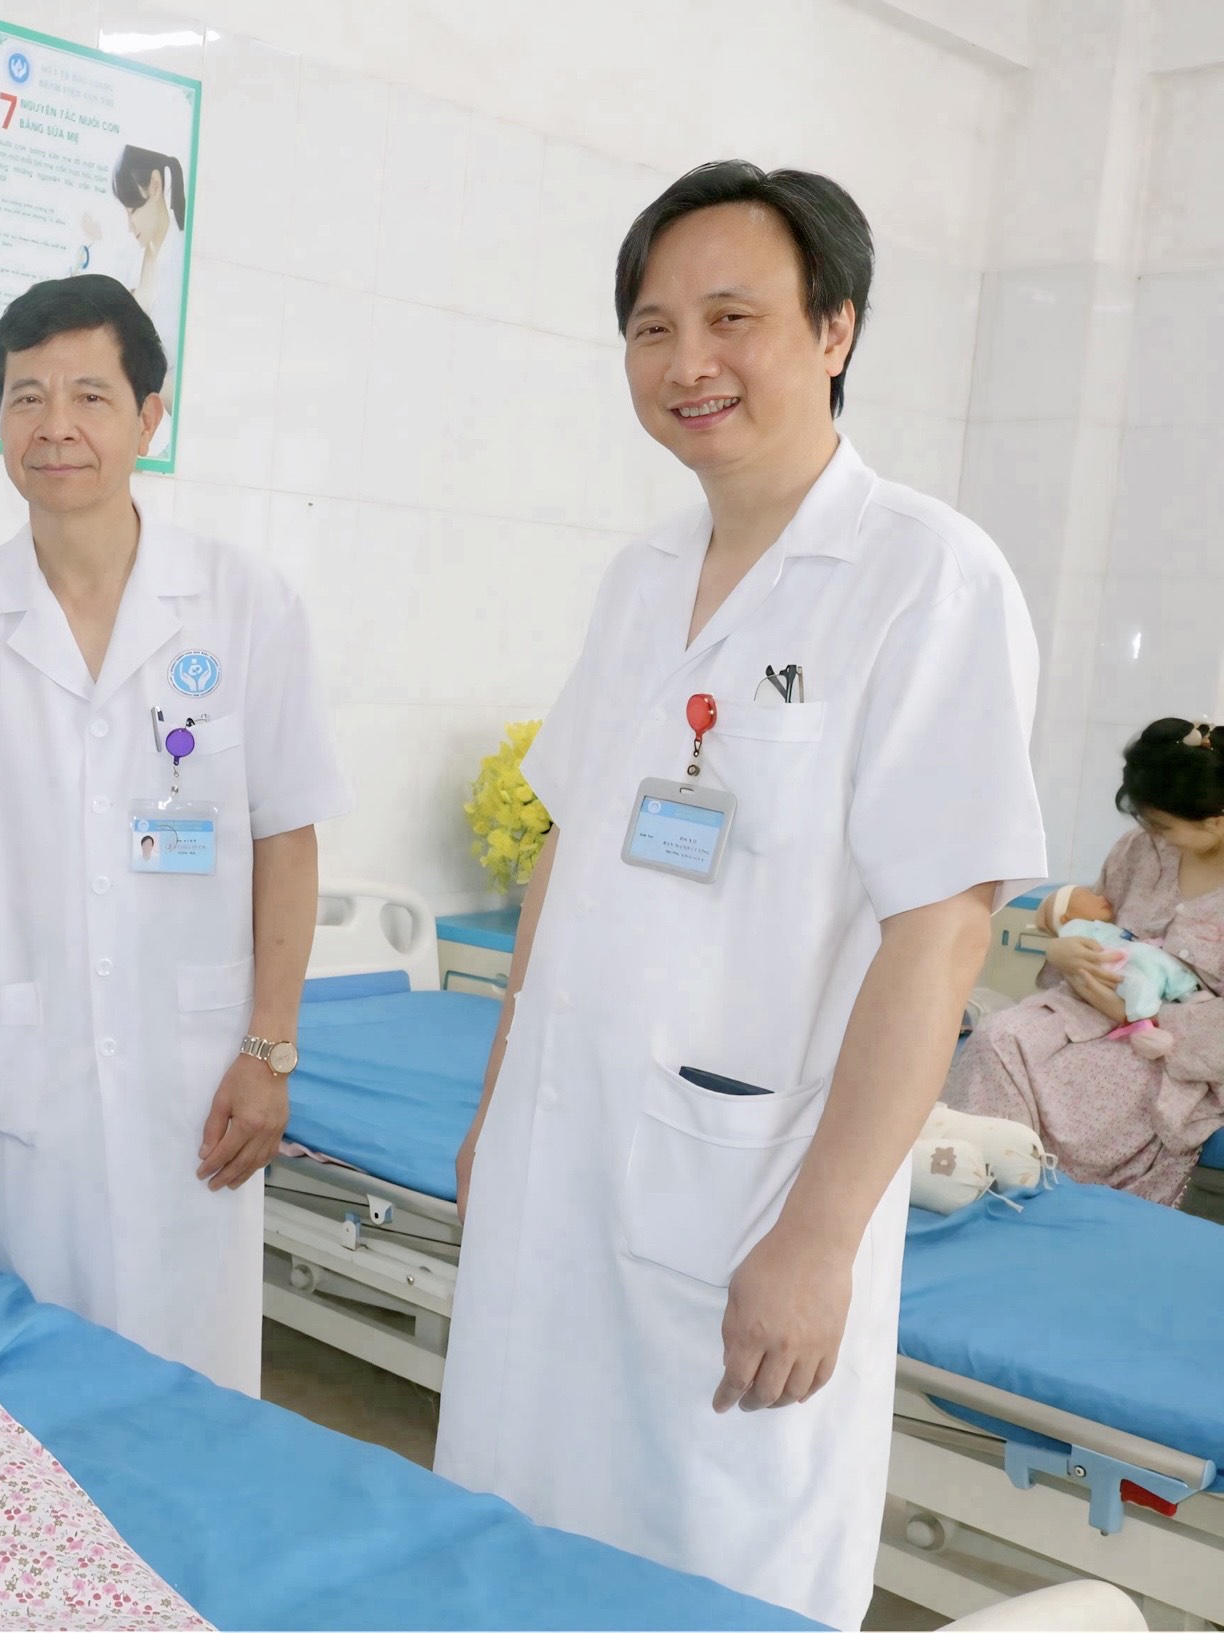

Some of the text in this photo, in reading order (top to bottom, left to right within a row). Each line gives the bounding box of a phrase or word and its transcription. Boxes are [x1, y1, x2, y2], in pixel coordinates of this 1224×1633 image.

[0, 92, 18, 130] 7
[20, 98, 56, 117] NGUYÊN
[102, 122, 120, 134] CON
